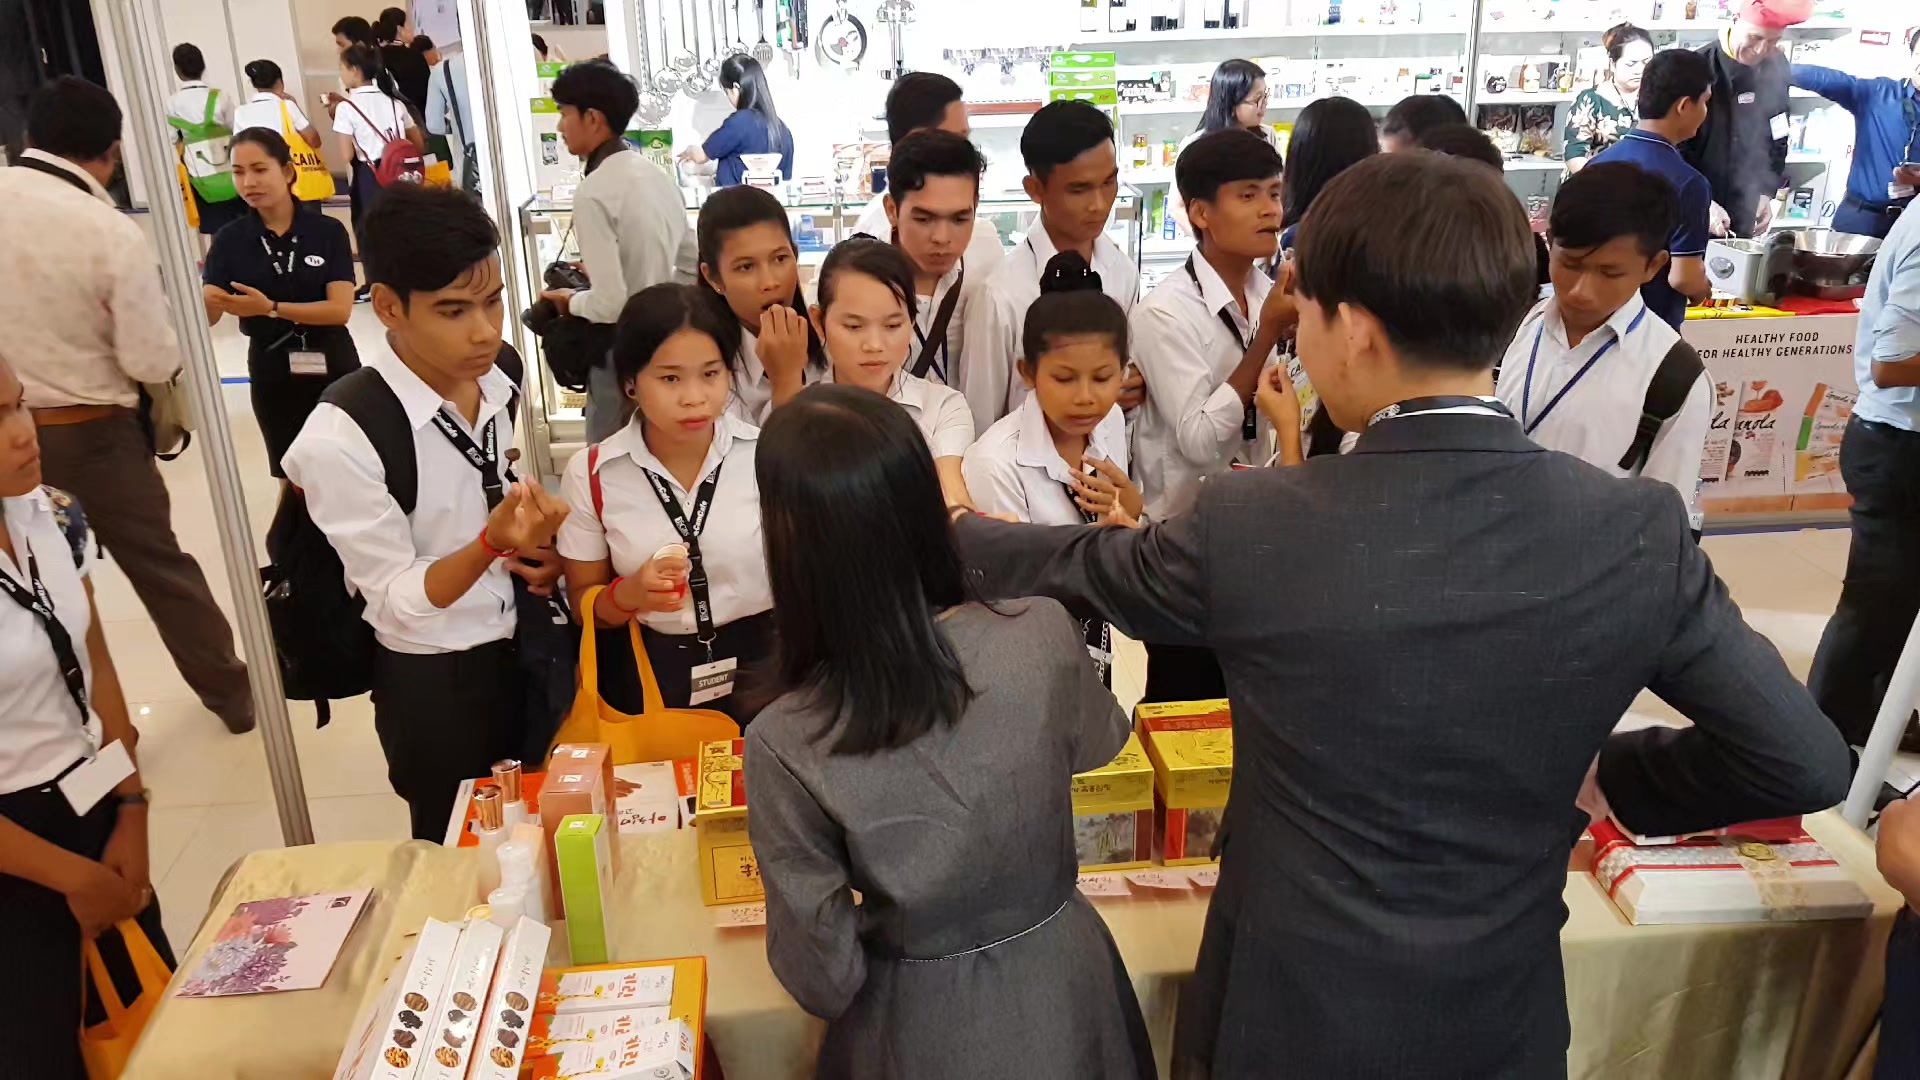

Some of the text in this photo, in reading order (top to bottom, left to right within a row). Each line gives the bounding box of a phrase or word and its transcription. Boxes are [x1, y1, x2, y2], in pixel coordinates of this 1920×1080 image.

[1735, 331, 1819, 345] HEALTHY FOOD
[1697, 344, 1853, 360] FOR HEALTHY GENERATIONS
[698, 673, 729, 688] STUDENT
